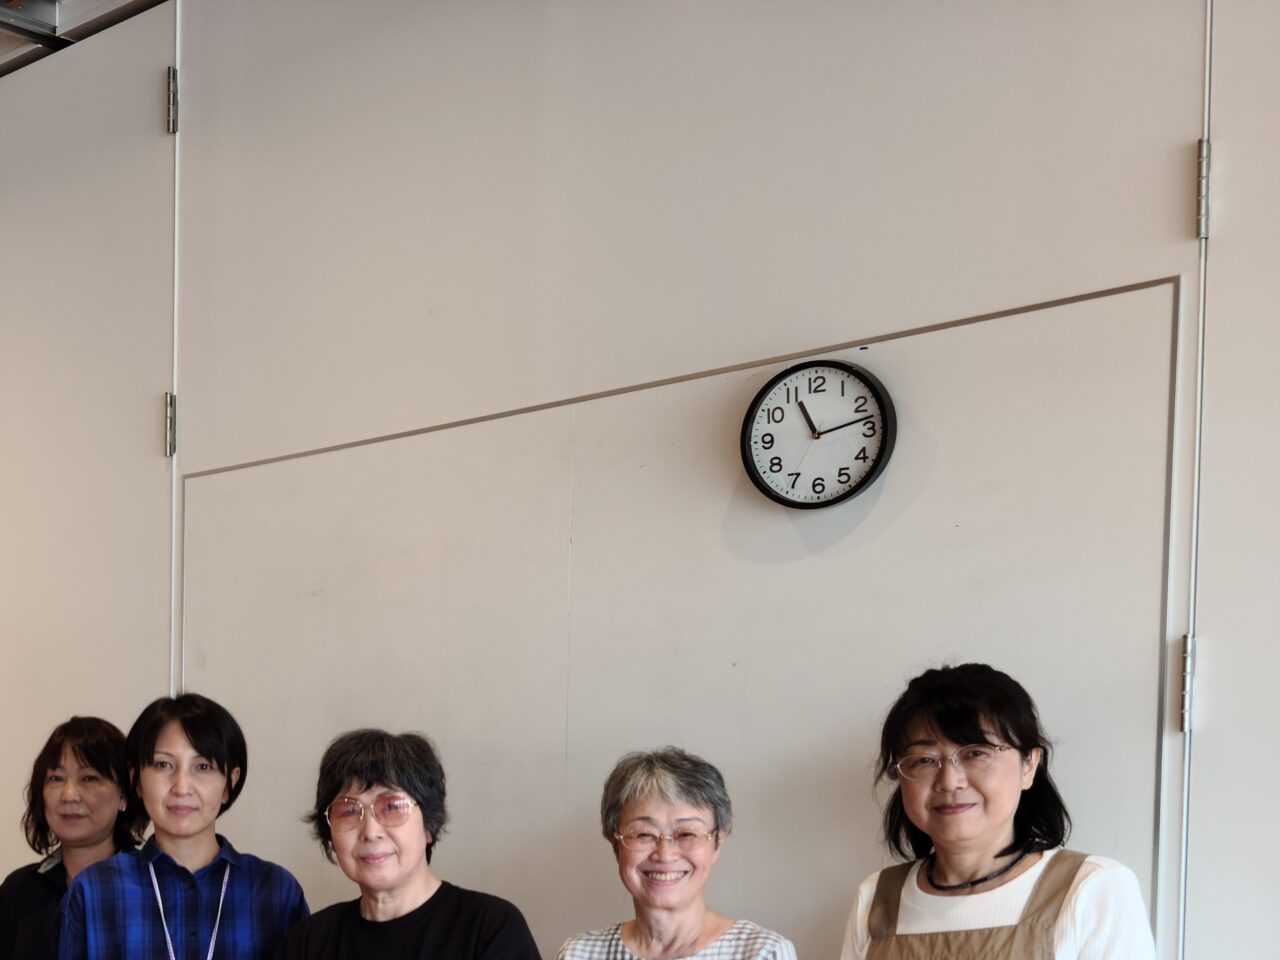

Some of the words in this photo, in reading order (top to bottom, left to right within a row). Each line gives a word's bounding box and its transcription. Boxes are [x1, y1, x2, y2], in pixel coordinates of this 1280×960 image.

[808, 376, 826, 394] 12
[841, 380, 845, 396] 1
[786, 386, 798, 404] 11
[854, 396, 868, 413] 2
[767, 406, 784, 424] 10
[862, 420, 876, 438] 3
[761, 433, 774, 450] 9
[854, 446, 869, 463] 4
[769, 456, 782, 473] 8
[787, 472, 801, 489] 7
[837, 467, 851, 484] 5
[811, 477, 825, 494] 6
